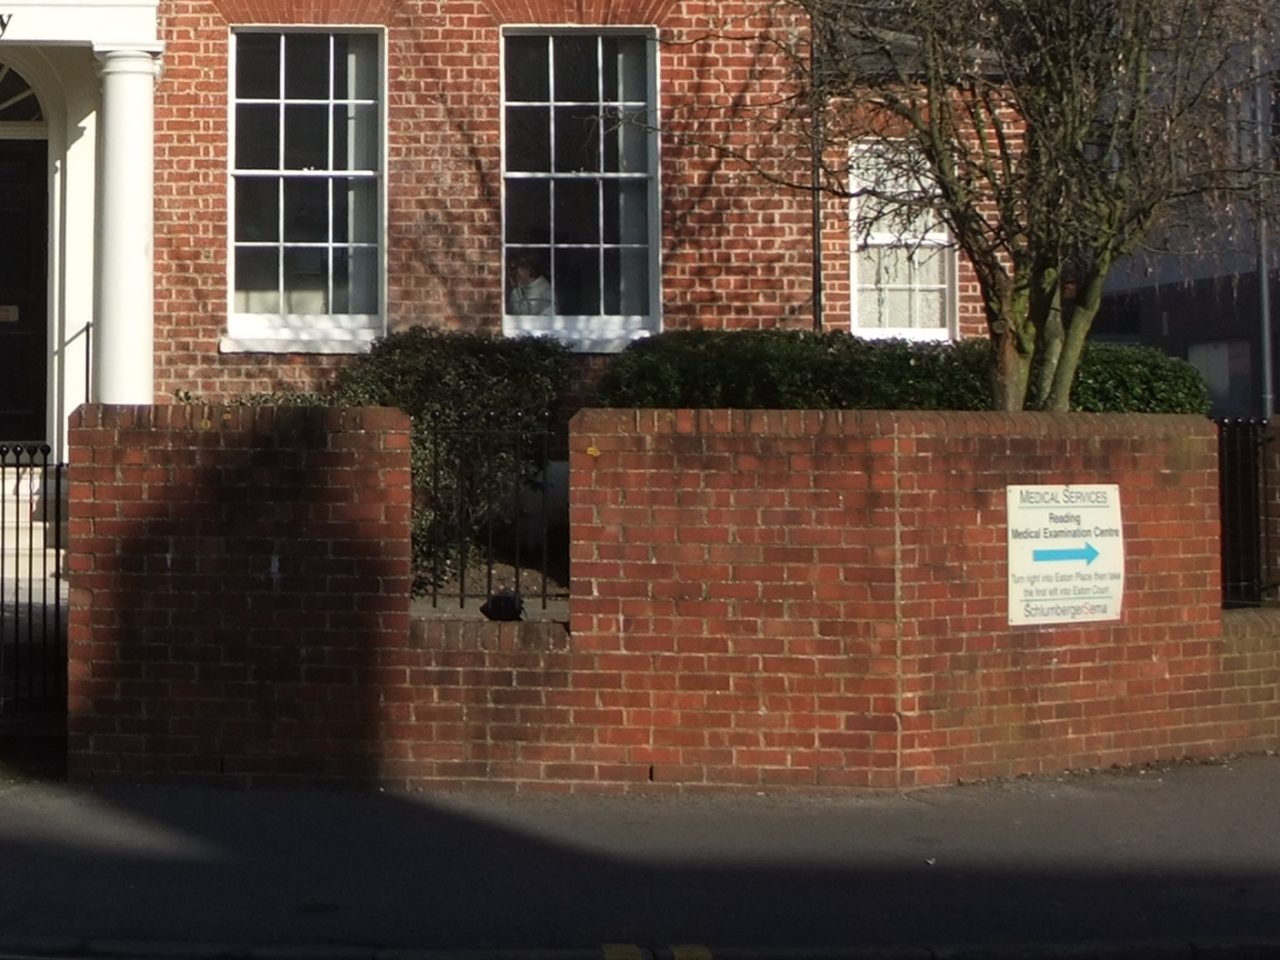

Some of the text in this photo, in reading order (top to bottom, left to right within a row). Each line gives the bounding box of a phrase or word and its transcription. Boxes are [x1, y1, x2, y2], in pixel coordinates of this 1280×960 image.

[1019, 489, 1107, 504] MEDICAL SERVICES
[1048, 512, 1081, 525] Reading
[1011, 526, 1120, 539] Medical Examination Centre
[1026, 573, 1040, 585] right
